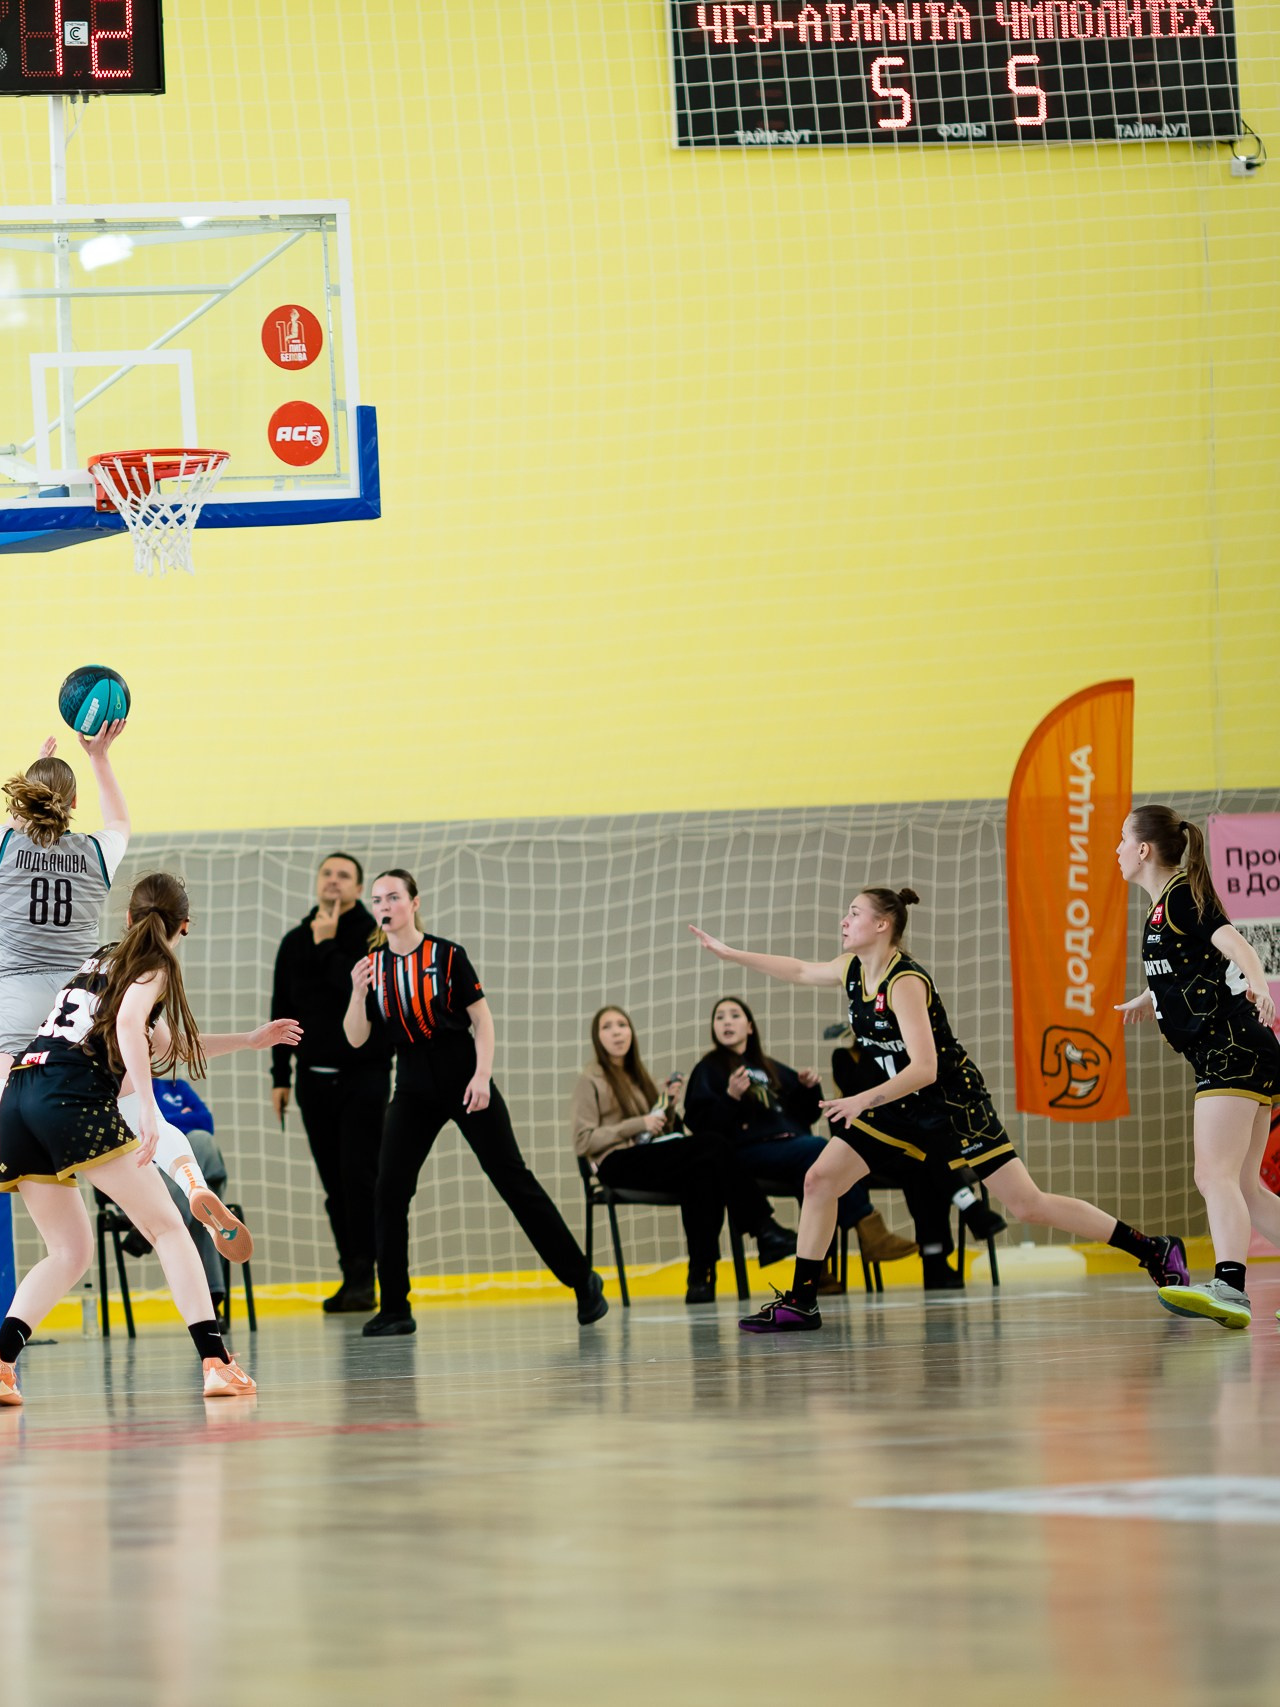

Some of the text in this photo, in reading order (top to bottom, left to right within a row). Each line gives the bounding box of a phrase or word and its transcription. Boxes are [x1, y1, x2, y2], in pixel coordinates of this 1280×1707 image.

[697, 2, 971, 43] ЧГУ-АТЛАНТА
[871, 54, 1047, 128] 5 5
[734, 128, 812, 144] ТАЙМ-АУТ
[937, 123, 986, 138] ФОЛЫ
[1115, 121, 1189, 138] ТАЙМ-АУТ
[15, 849, 88, 874] ПОДЪЯНОВА
[1226, 847, 1280, 871] Про
[1064, 744, 1095, 1017] ДОДО ПИЦЦА
[1227, 877, 1241, 894] в
[29, 877, 73, 927] 88
